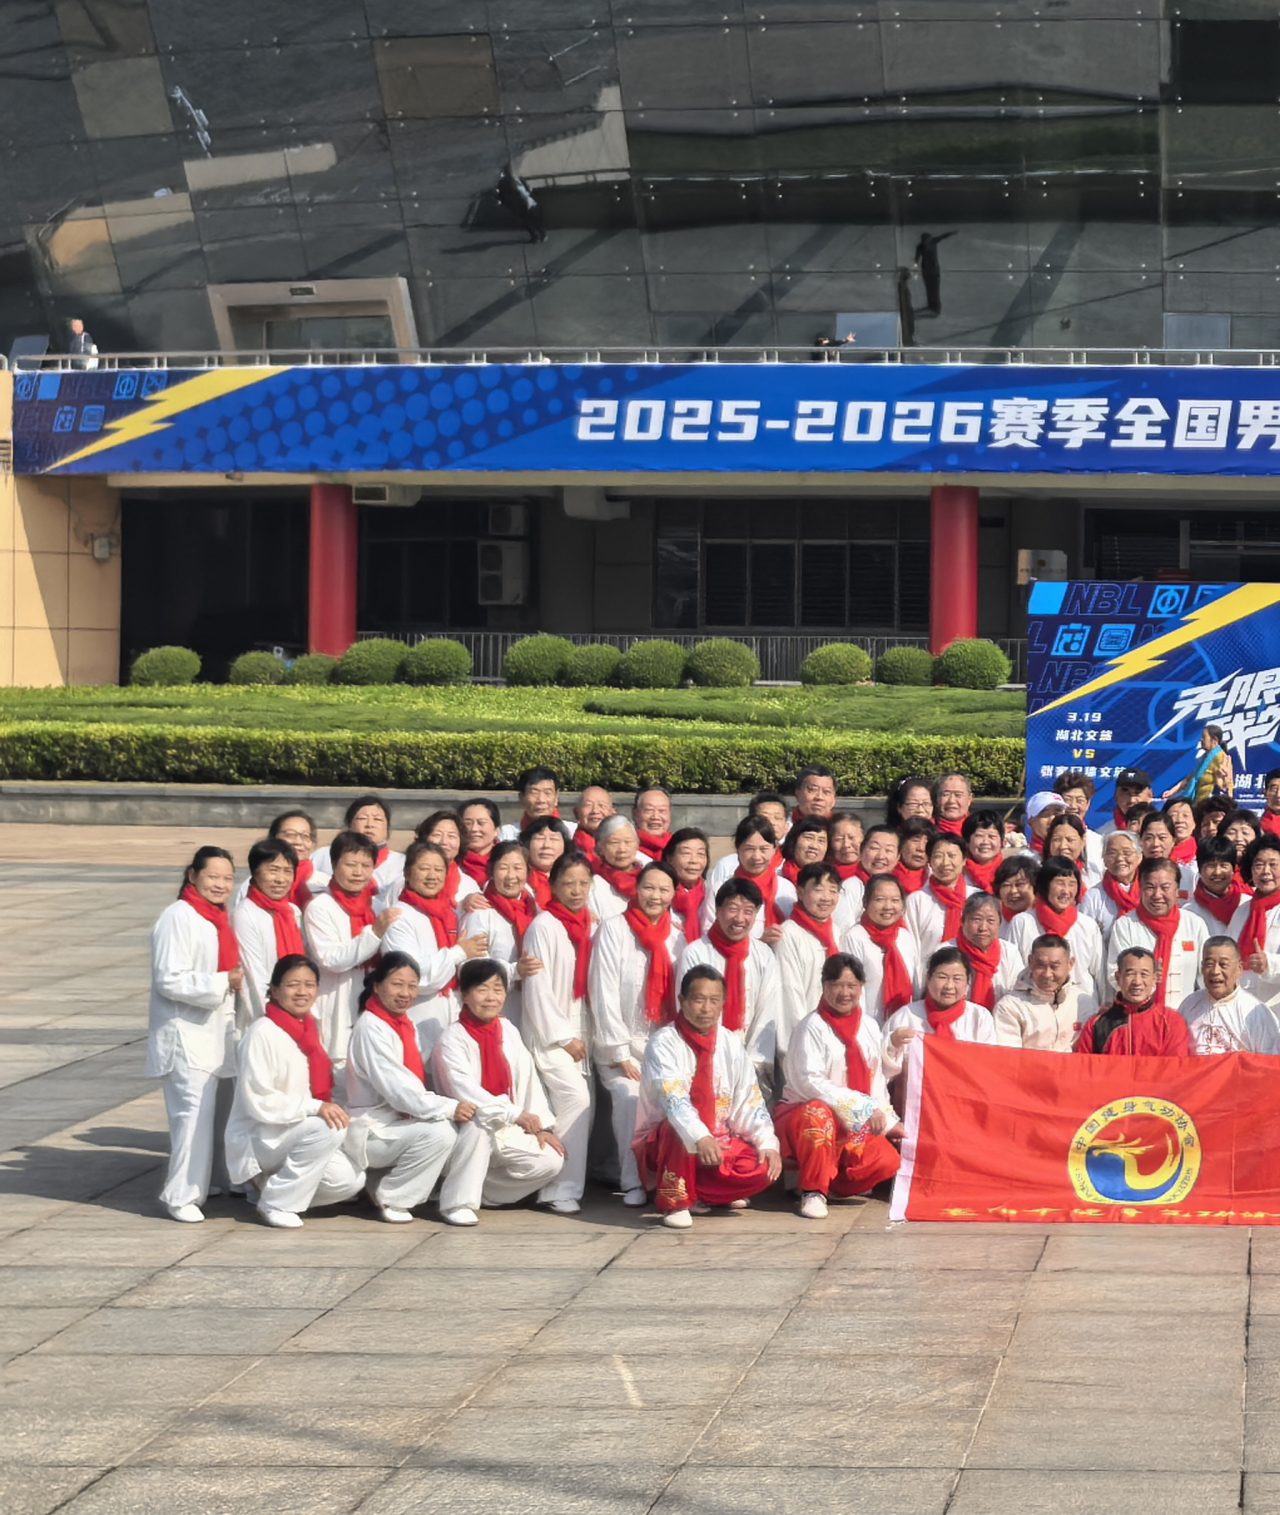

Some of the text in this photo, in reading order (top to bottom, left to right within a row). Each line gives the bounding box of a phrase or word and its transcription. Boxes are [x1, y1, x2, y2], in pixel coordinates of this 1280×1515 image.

[1063, 583, 1142, 616] NBL
[1067, 712, 1102, 722] 3.19
[1073, 749, 1096, 759] VS
